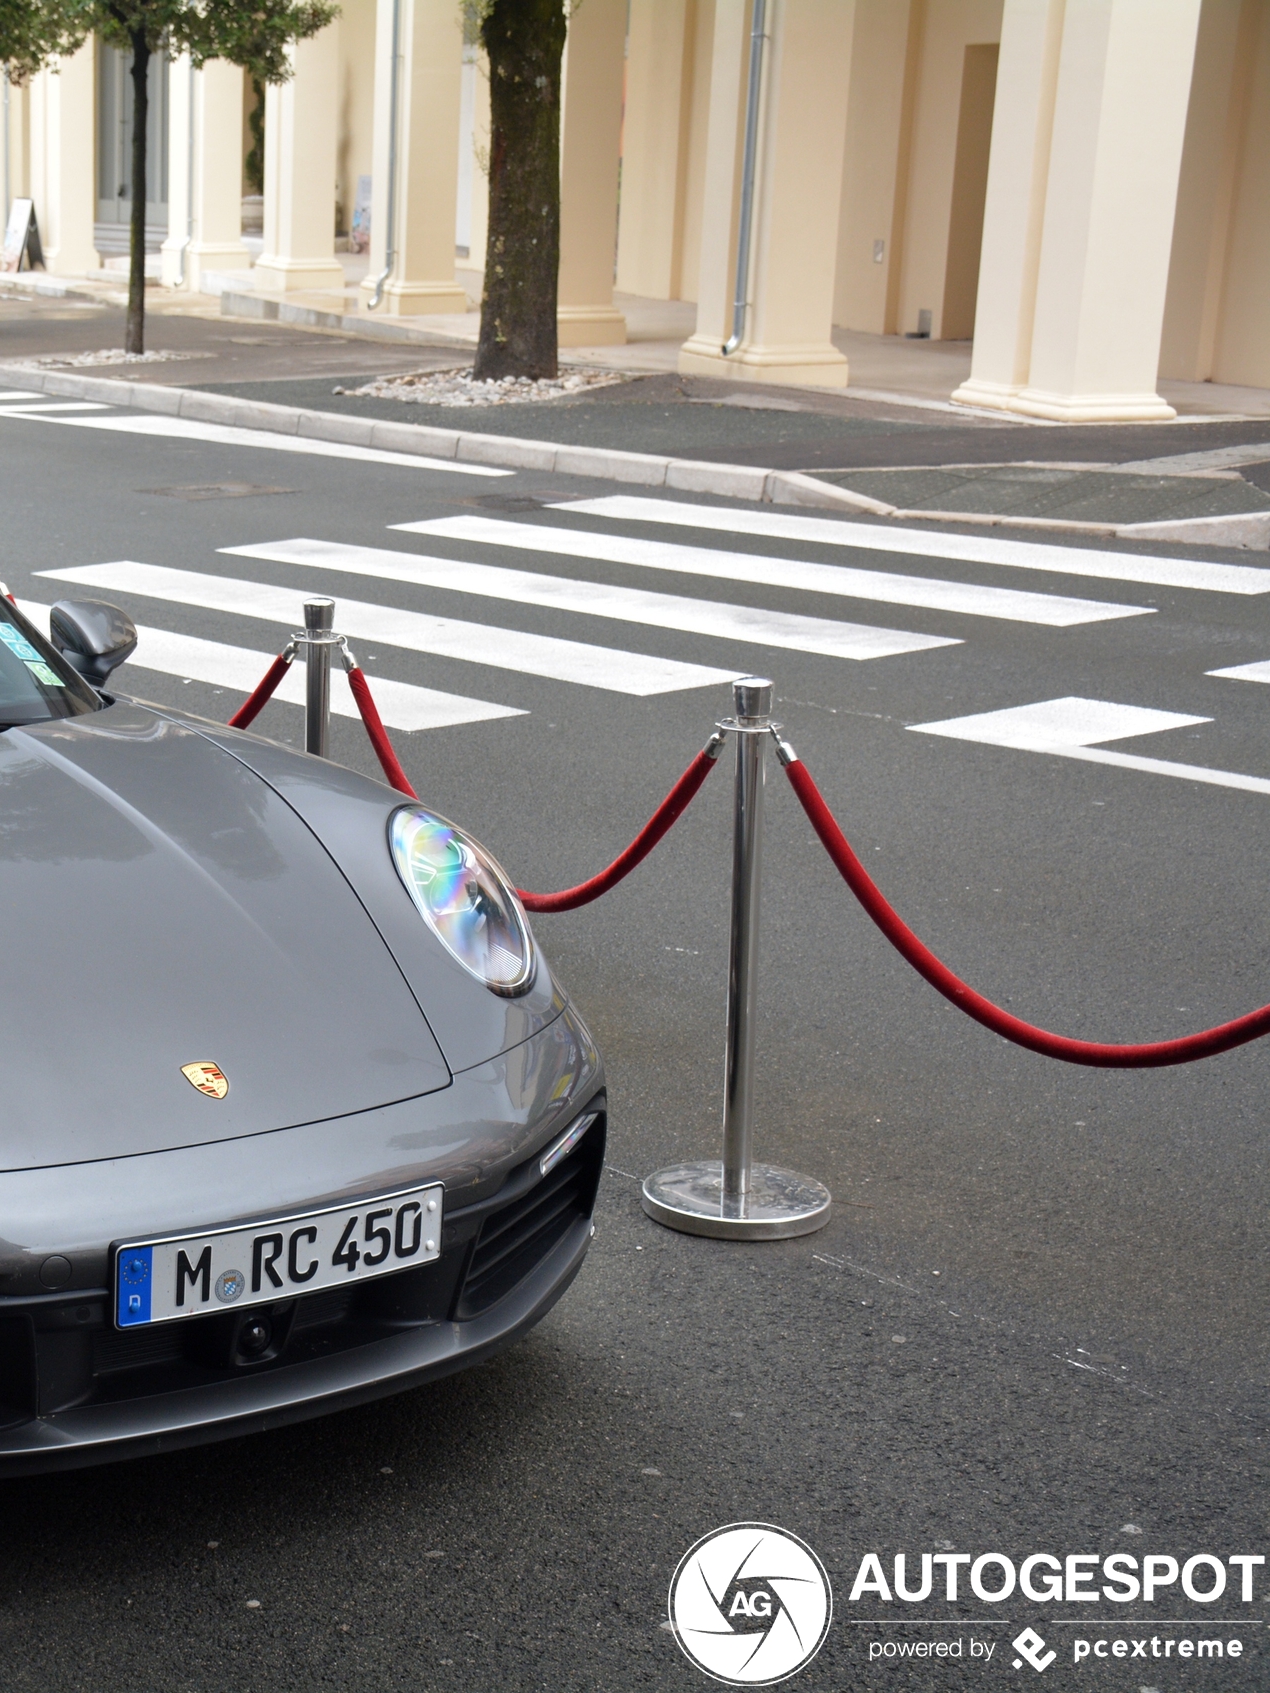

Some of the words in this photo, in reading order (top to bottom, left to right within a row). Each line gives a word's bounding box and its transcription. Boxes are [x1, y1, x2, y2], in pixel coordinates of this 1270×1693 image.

[175, 1245, 212, 1307] M
[251, 1225, 320, 1293] RC
[331, 1200, 423, 1273] 450
